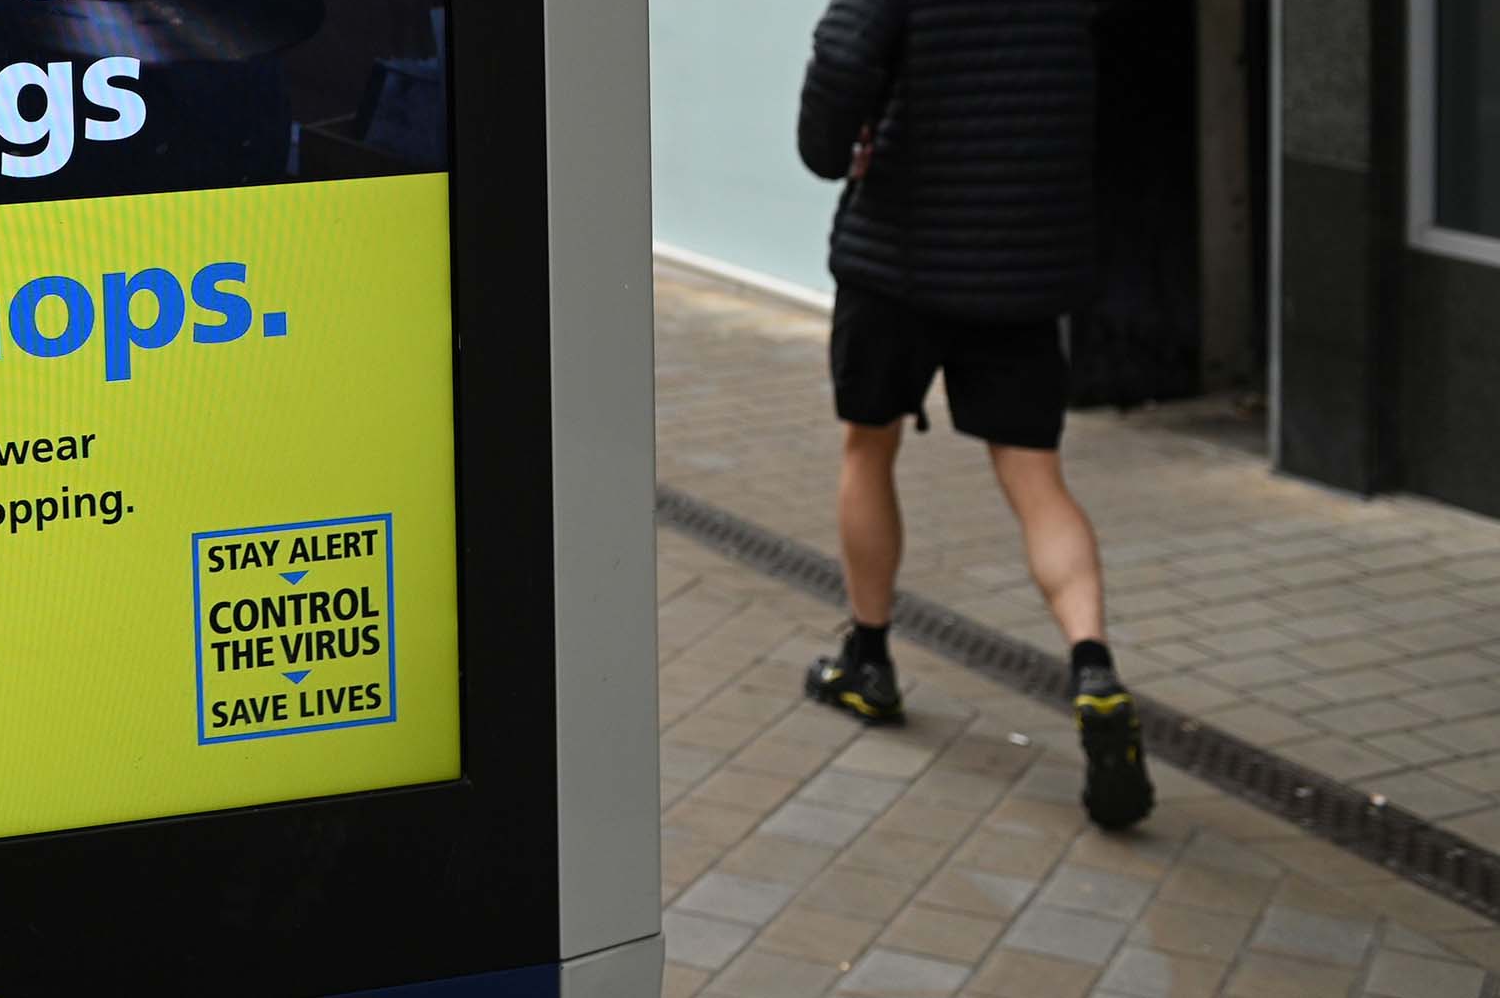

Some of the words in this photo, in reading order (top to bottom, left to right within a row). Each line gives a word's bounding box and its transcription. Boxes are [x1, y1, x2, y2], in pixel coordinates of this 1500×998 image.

[207, 539, 280, 573] STAY
[288, 529, 379, 565] ALERT
[208, 586, 380, 635] CONTROL
[210, 636, 275, 672] THE
[279, 624, 381, 664] VIRUS
[211, 693, 288, 728] SAVE
[299, 682, 382, 718] LIVES
